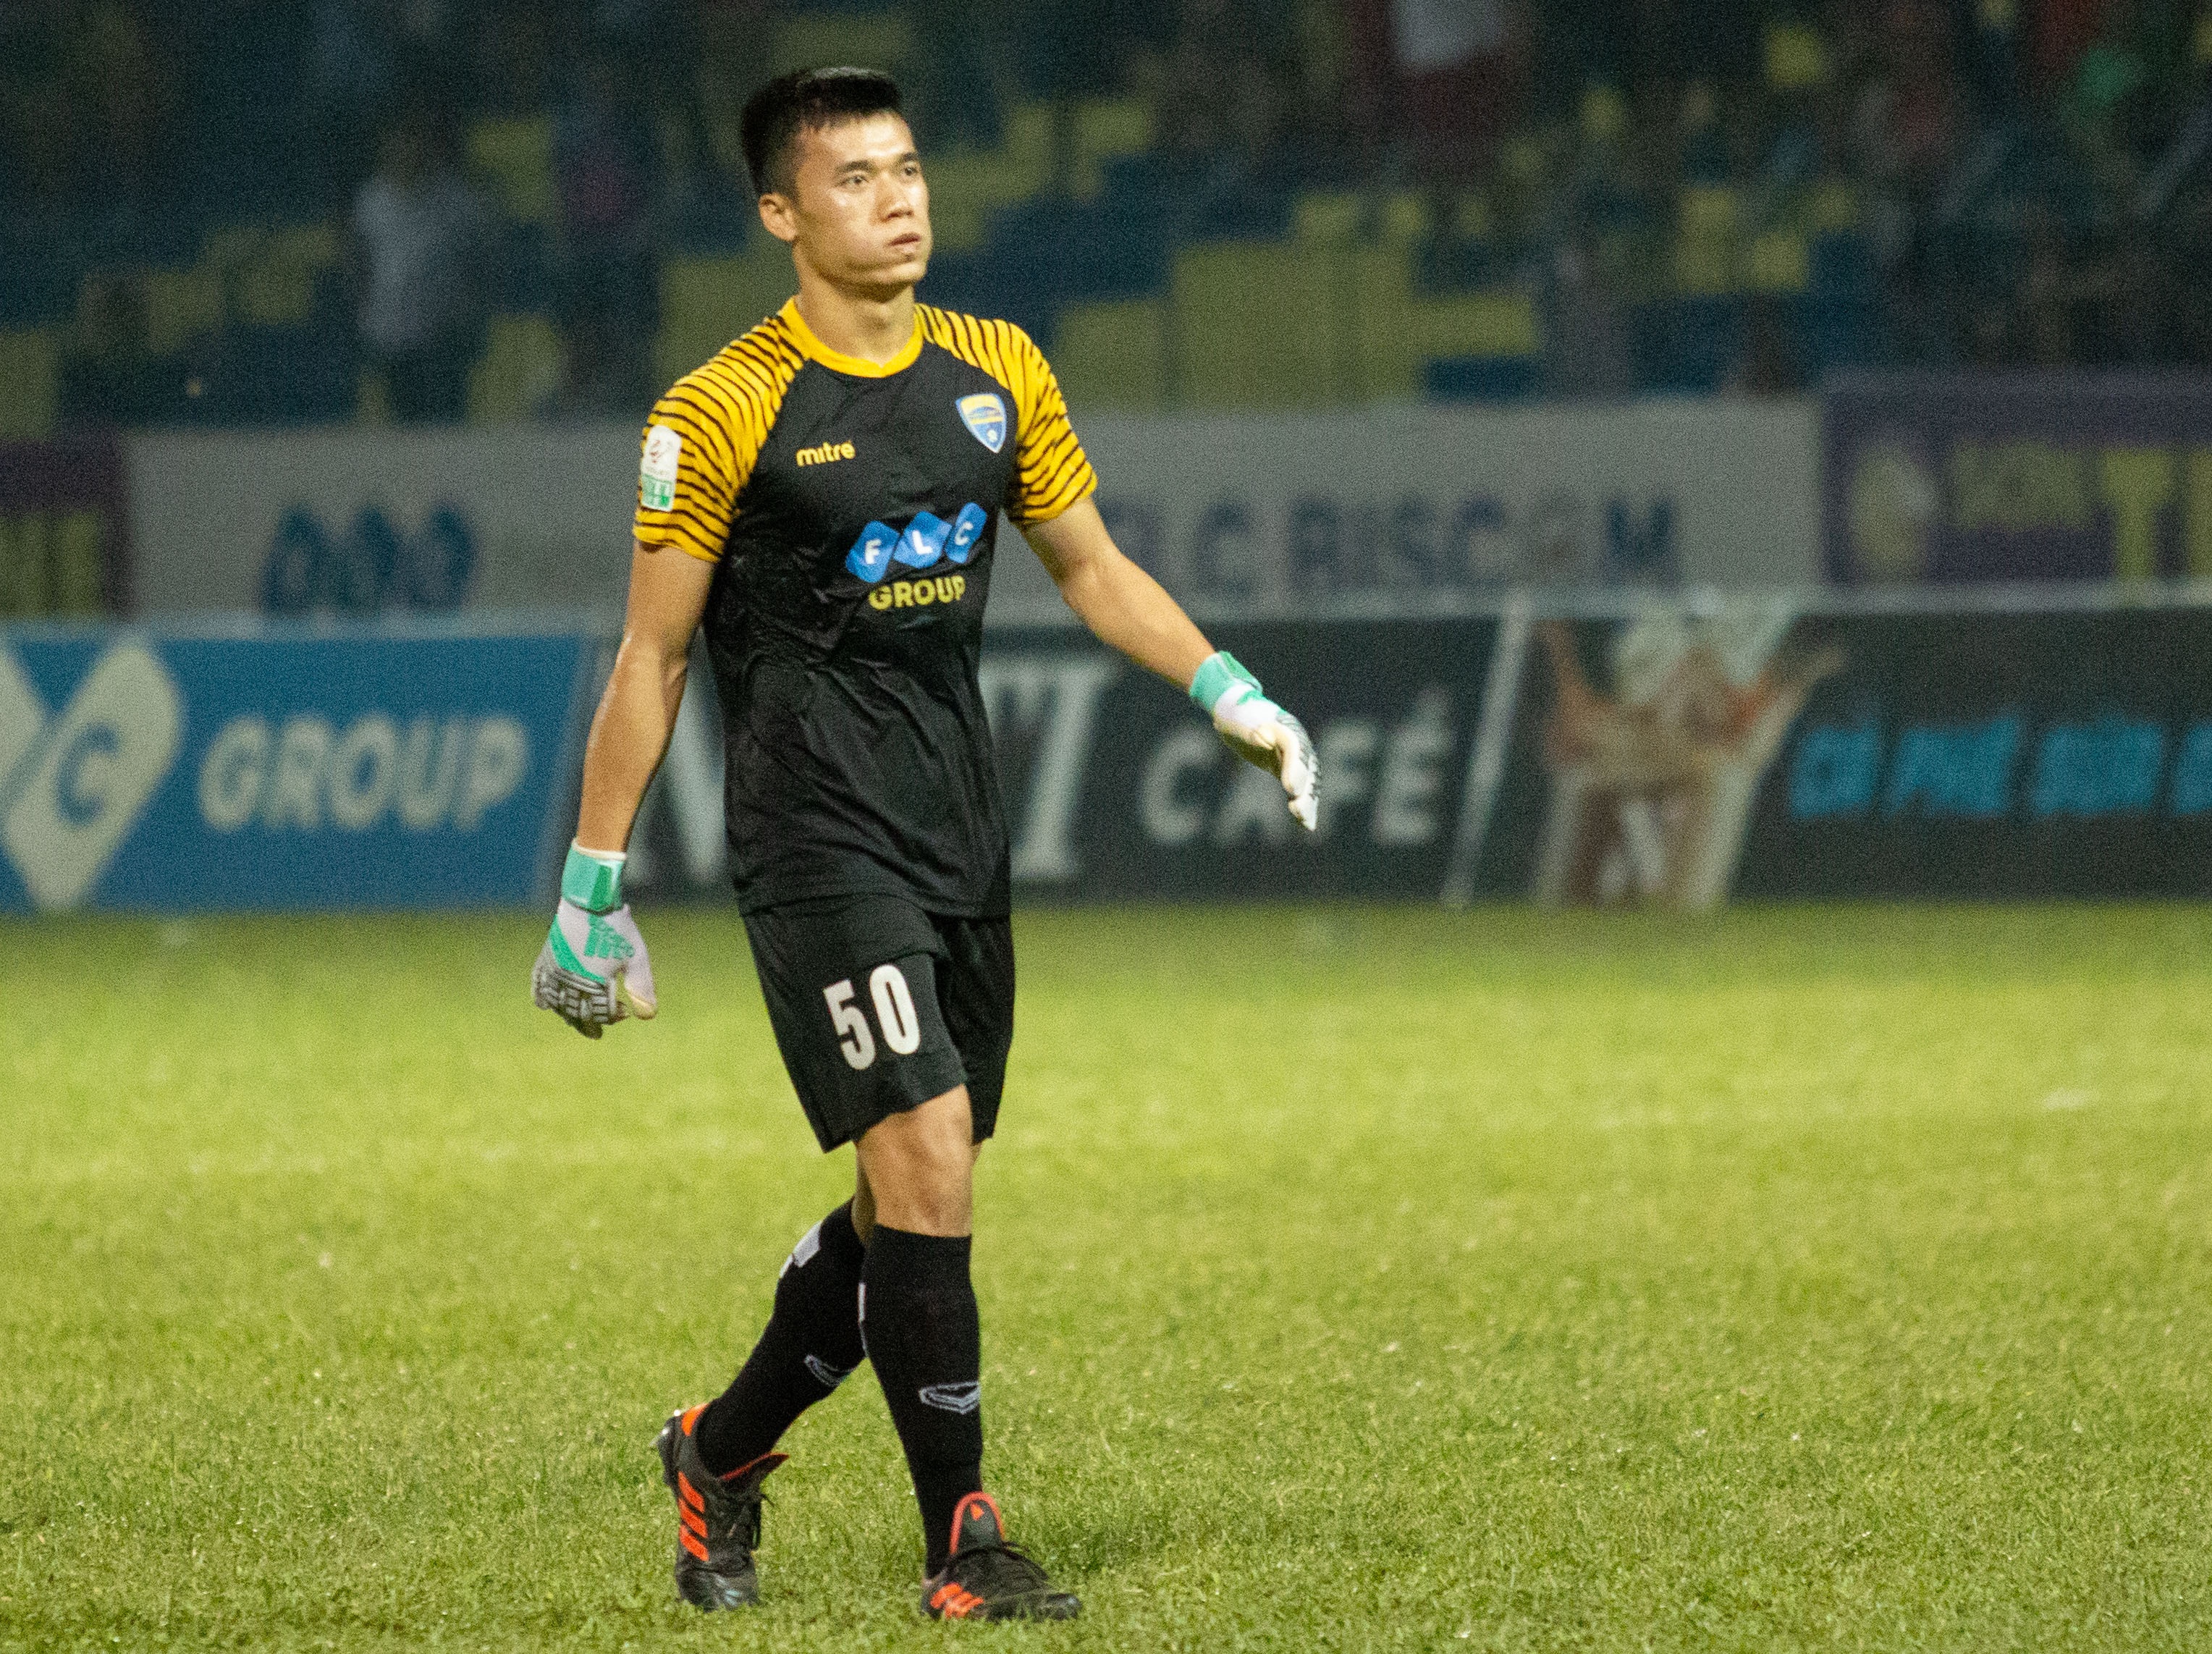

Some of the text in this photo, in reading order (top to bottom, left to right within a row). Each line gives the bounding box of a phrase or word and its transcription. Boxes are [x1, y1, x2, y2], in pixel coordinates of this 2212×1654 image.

[795, 440, 856, 467] mitre
[864, 521, 974, 565] FLC
[869, 575, 966, 611] GROUP
[197, 712, 530, 834] GROUP
[822, 963, 921, 1071] 50
